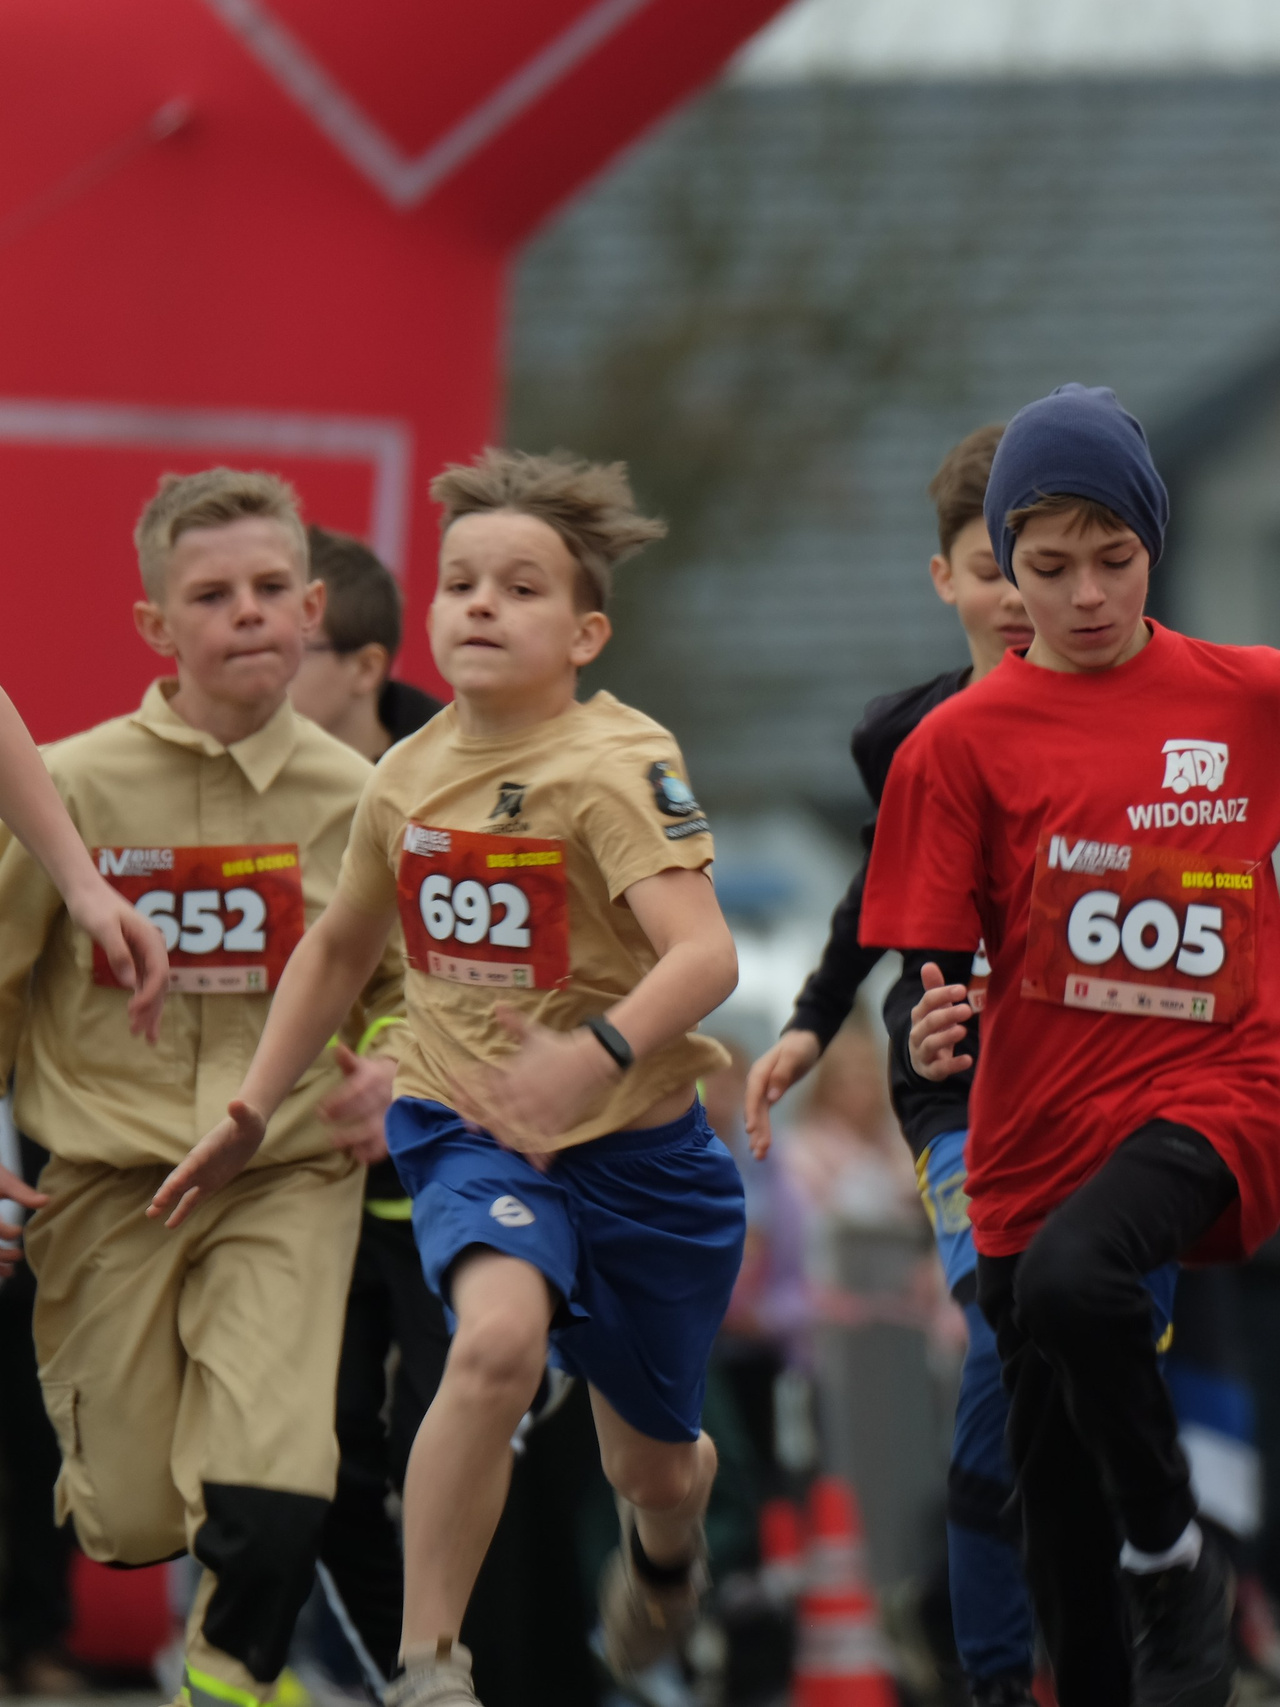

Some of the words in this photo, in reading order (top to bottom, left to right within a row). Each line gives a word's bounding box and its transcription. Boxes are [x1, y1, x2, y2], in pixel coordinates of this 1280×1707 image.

[1127, 798, 1248, 831] WIDORADZ
[99, 848, 130, 876] IV
[1048, 834, 1088, 872] IV
[1182, 871, 1214, 888] BIEG
[1215, 873, 1253, 889] DZIECI
[133, 887, 266, 954] 652
[419, 874, 531, 948] 692
[1067, 889, 1226, 977] 605
